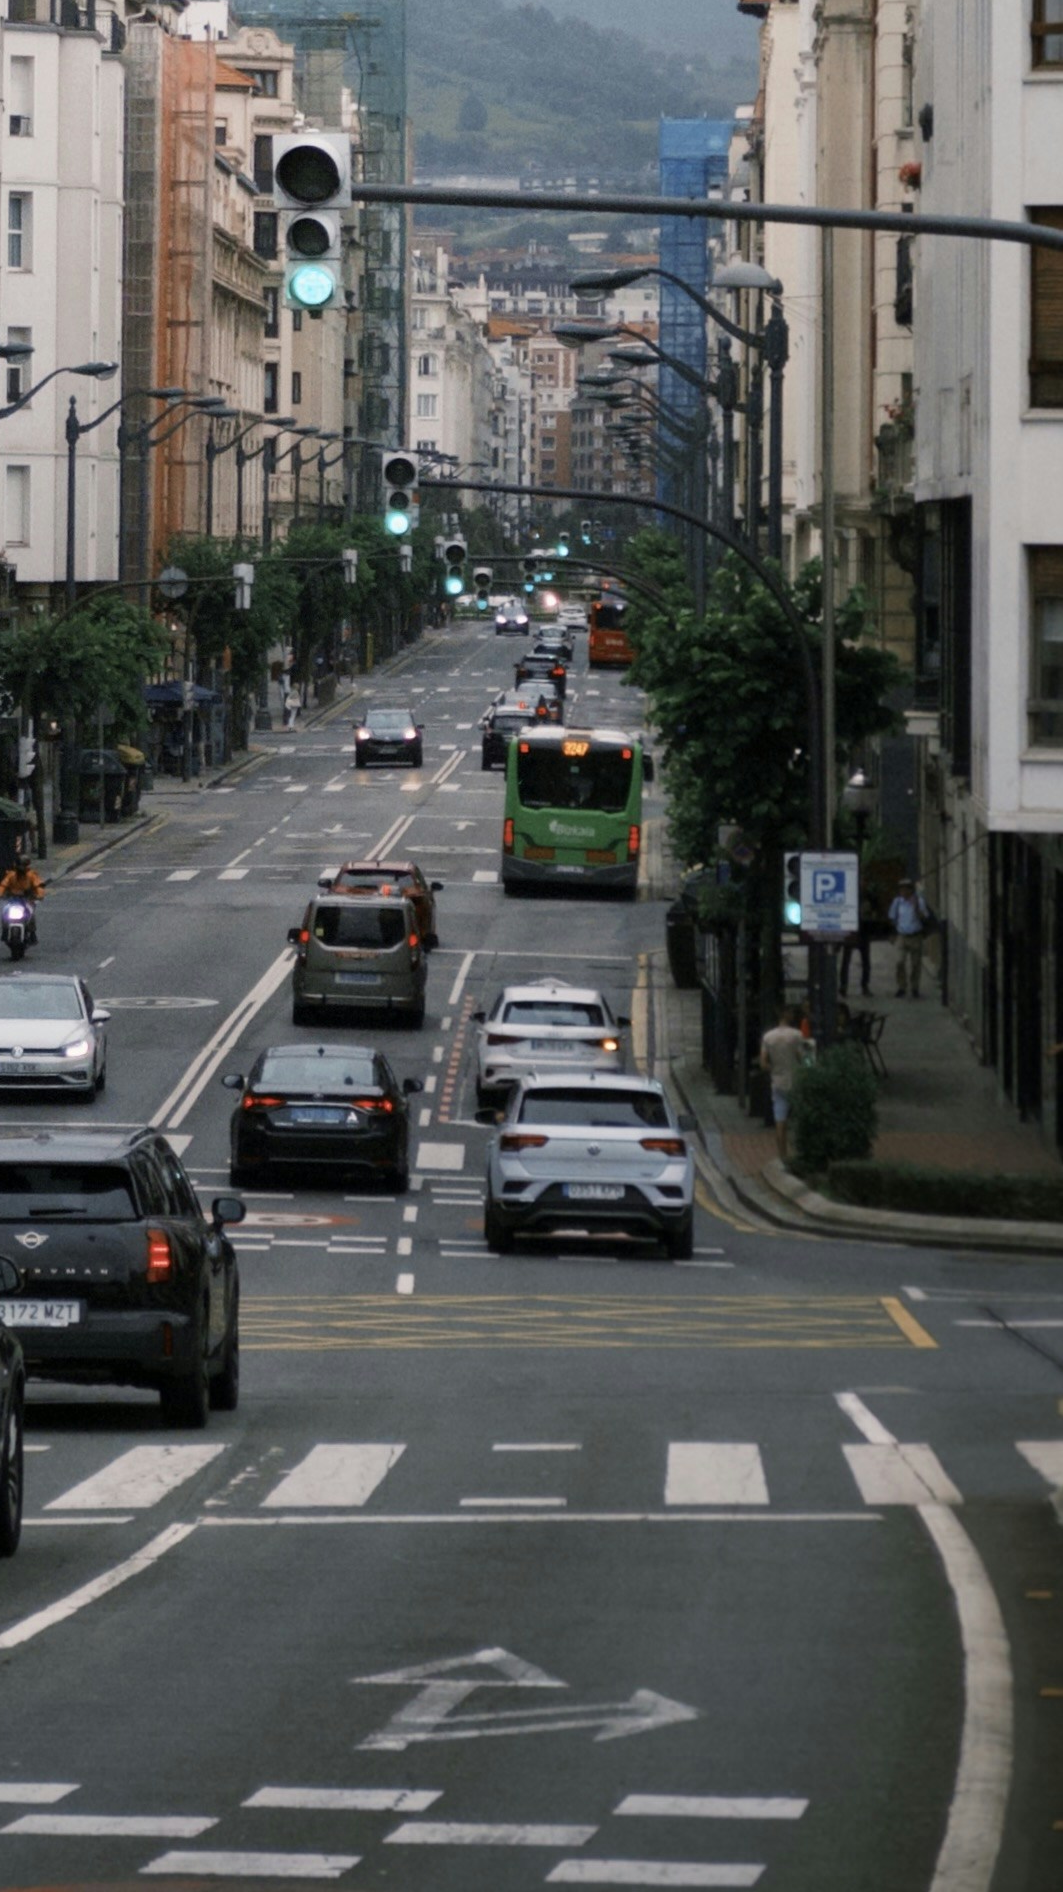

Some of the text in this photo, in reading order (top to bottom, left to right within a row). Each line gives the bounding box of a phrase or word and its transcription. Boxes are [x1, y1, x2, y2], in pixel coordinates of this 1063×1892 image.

[563, 740, 589, 756] 3247
[816, 873, 836, 901] P
[44, 1304, 74, 1321] MZT
